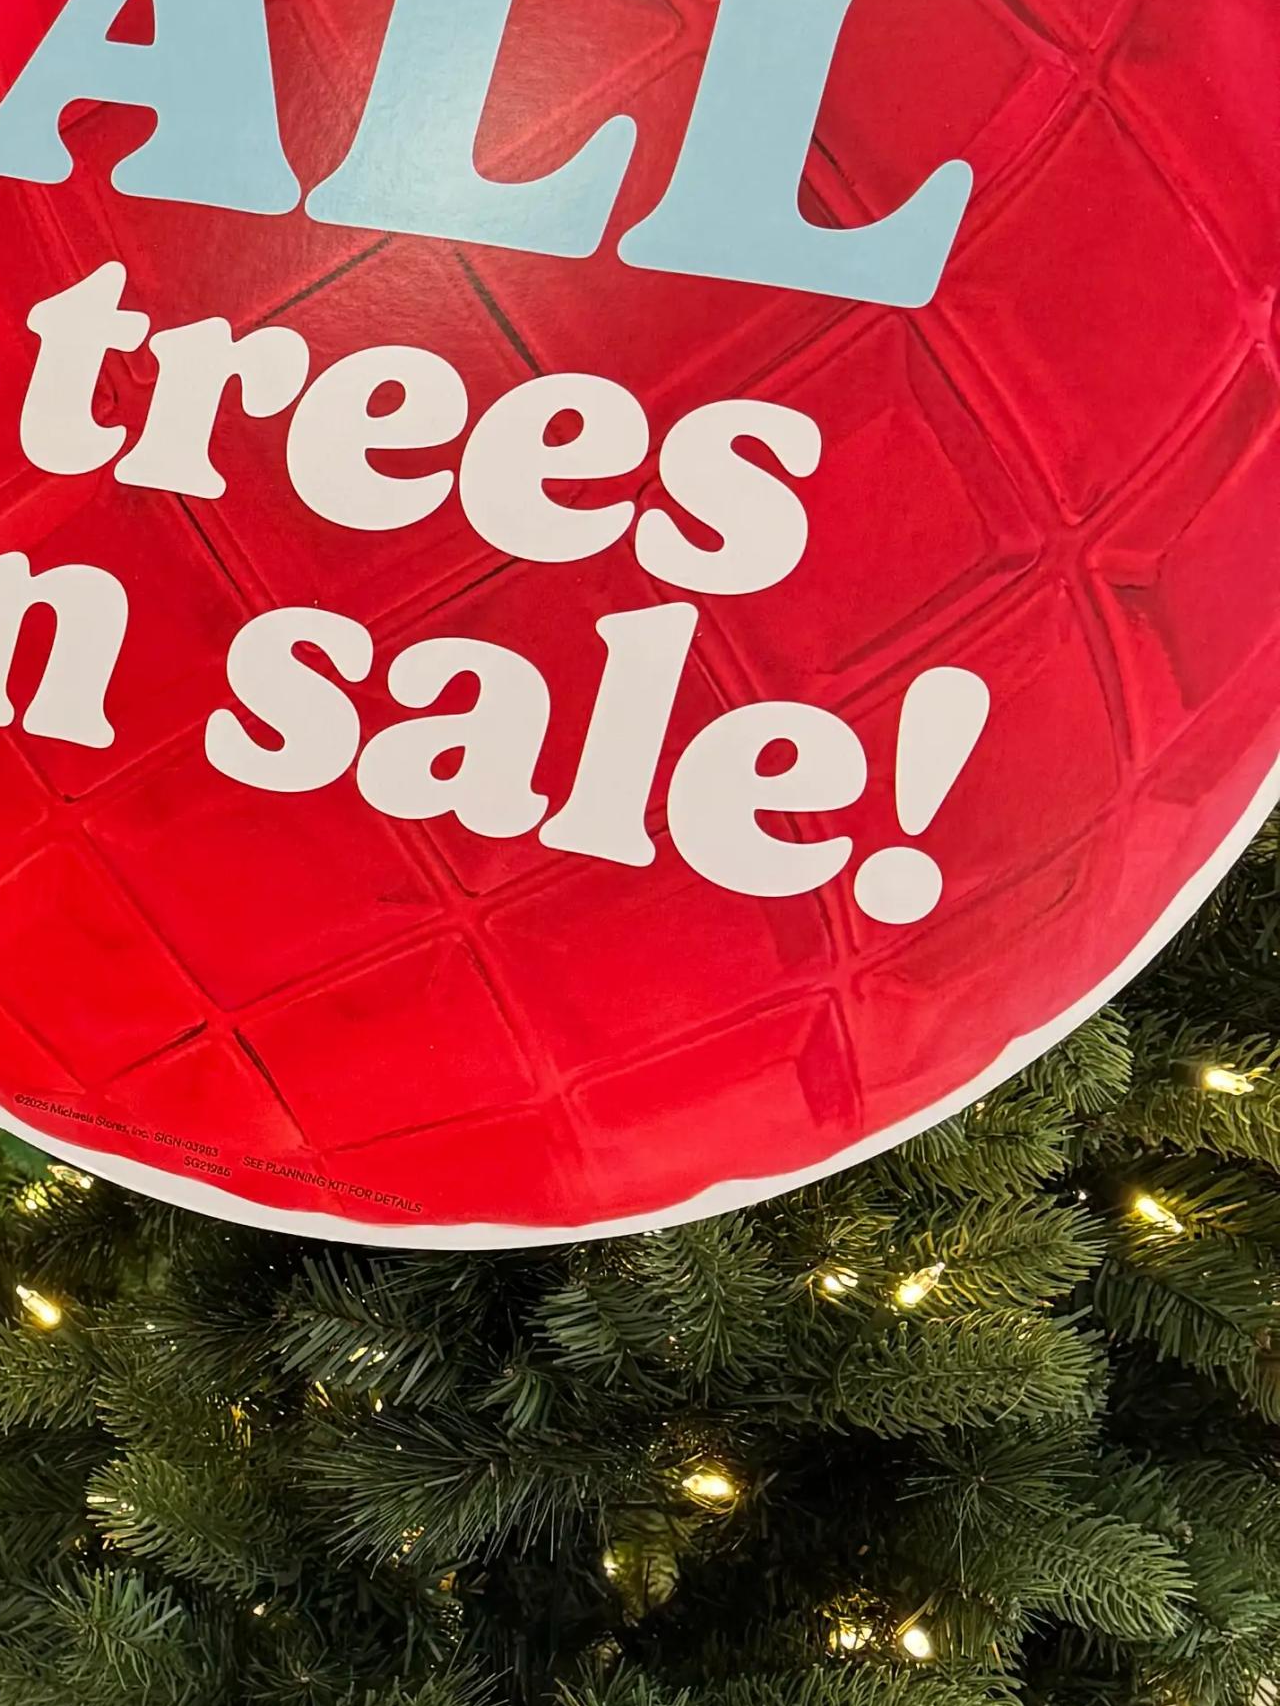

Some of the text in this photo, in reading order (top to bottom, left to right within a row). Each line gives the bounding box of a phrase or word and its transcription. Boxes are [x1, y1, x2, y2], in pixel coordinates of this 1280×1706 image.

[20, 260, 822, 596] trees
[205, 601, 992, 926] sale!
[50, 1103, 94, 1124] Michaels
[243, 1156, 423, 1213] SEE PLANNING KIT FOR DETAILS
